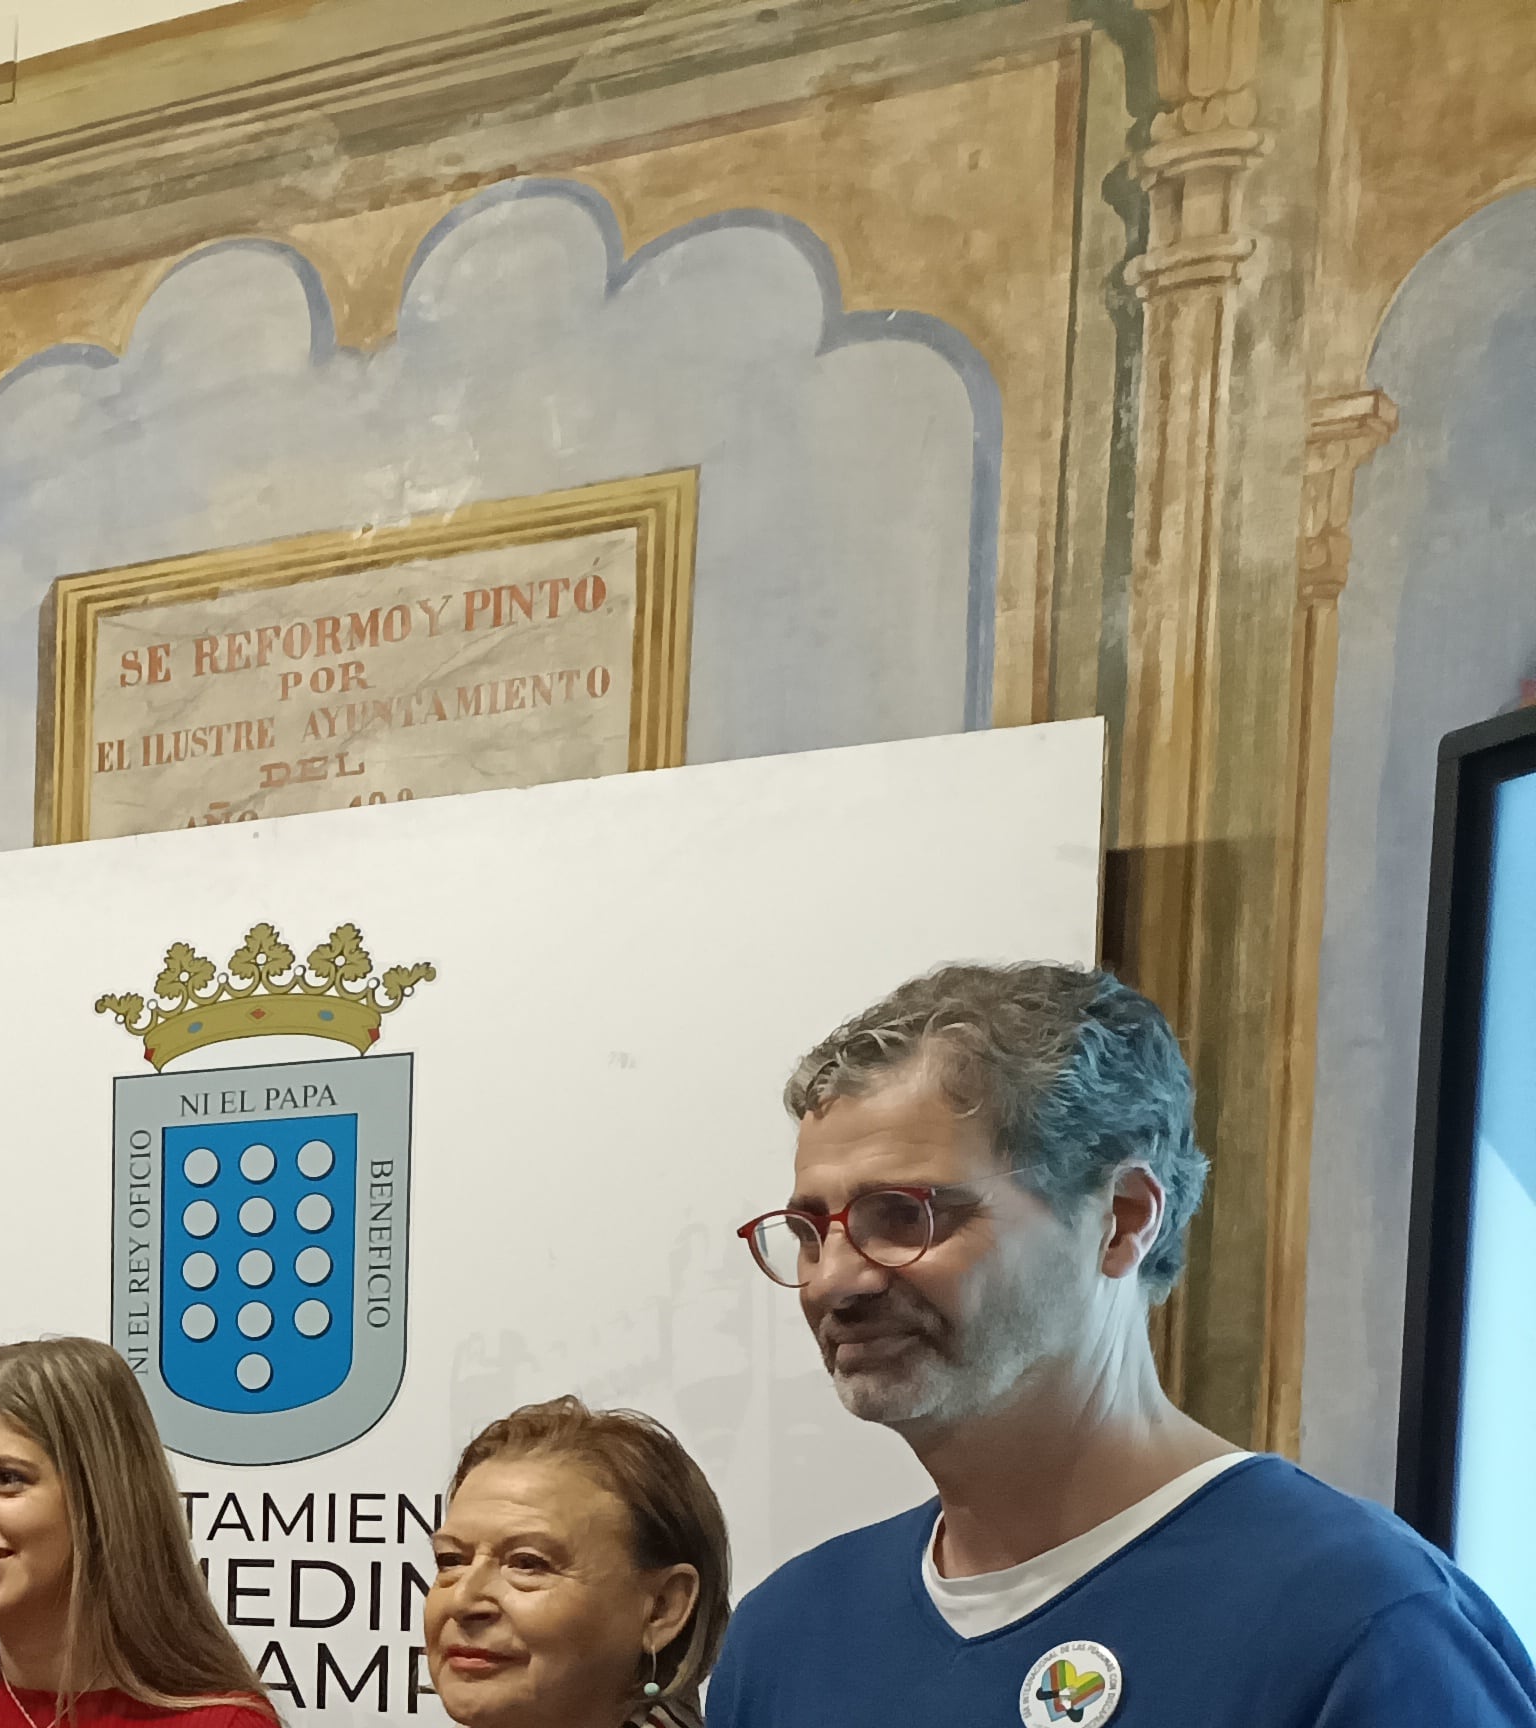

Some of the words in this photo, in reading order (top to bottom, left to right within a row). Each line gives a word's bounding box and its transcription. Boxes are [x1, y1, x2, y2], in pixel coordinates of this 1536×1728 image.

[119, 643, 171, 688] SE
[192, 603, 410, 678] REFORMO
[414, 595, 452, 638] Y
[278, 661, 376, 701] POR
[95, 740, 131, 774] EL
[142, 717, 276, 767] ILUSTRE
[301, 664, 611, 743] AYUNTAMIENTO
[260, 751, 366, 789] DEL
[180, 1092, 209, 1117] NI
[220, 1090, 255, 1114] EL
[264, 1084, 338, 1111] PAPA
[128, 1129, 152, 1229] OFICIO
[128, 1238, 150, 1293] REY
[366, 1159, 394, 1329] BENEFICIO
[128, 1303, 150, 1336] EL
[128, 1344, 149, 1376] NI
